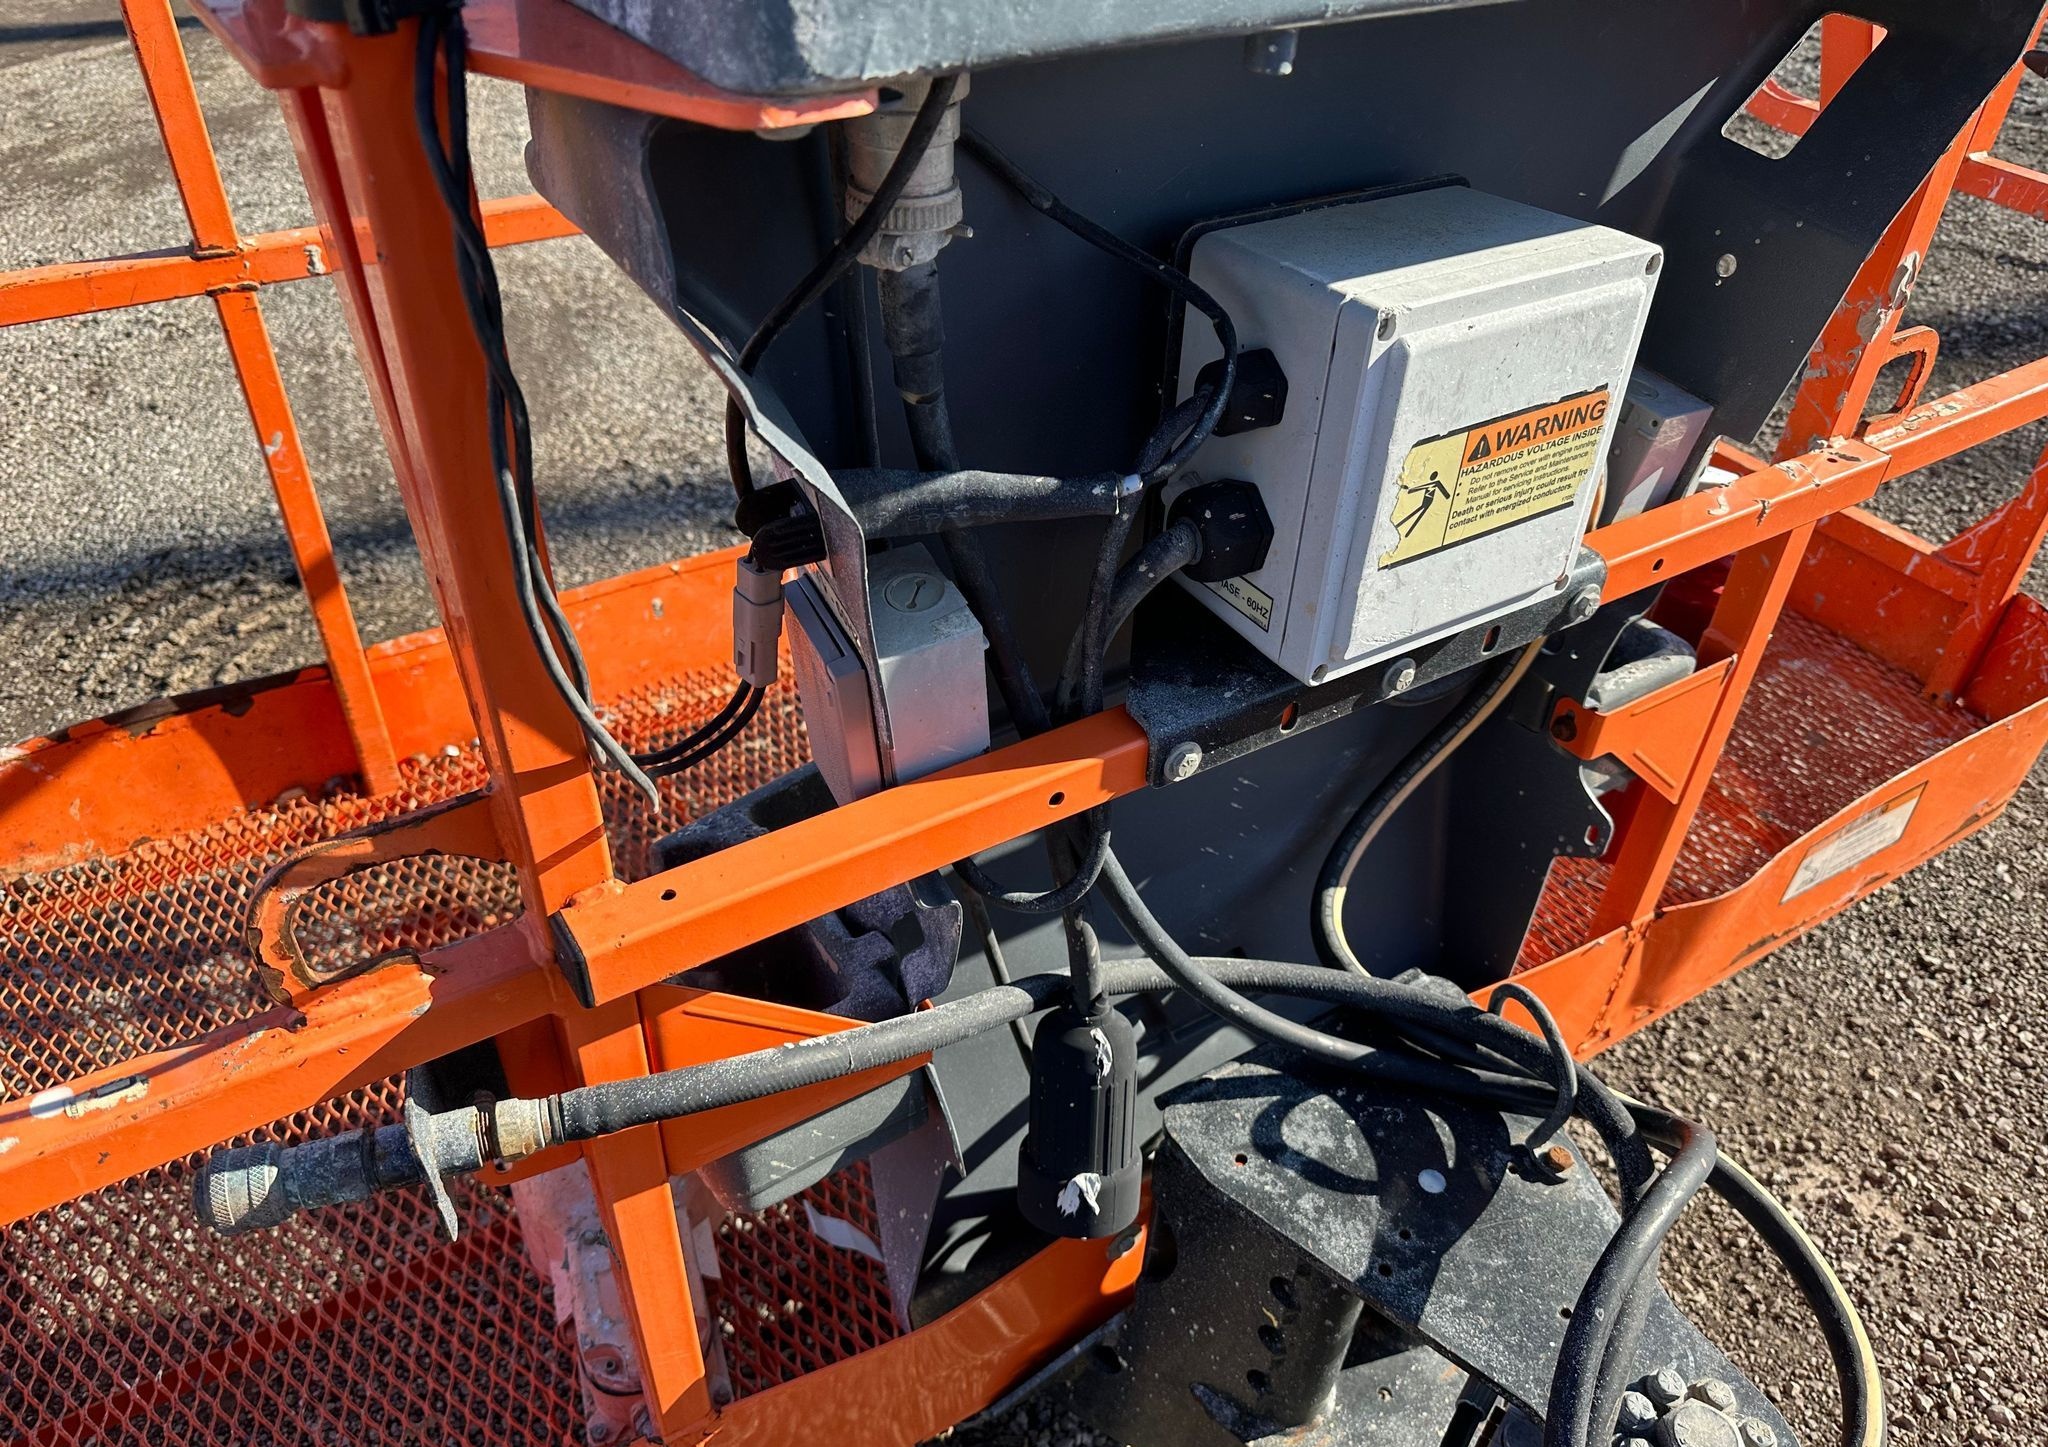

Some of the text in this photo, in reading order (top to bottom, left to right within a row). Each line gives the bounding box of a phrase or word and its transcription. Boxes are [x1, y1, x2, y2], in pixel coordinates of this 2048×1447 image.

[1496, 400, 1607, 451] WARNING
[1461, 425, 1603, 478] HAZARDOUS VOLTAGE INSIDE
[1467, 483, 1488, 495] Refer
[1496, 477, 1507, 486] the
[1508, 469, 1533, 481] Service
[1535, 465, 1548, 473] and
[1548, 451, 1589, 469] Maintenance
[1470, 477, 1480, 485] Do
[1482, 472, 1493, 481] not
[1494, 464, 1518, 477] remove
[1519, 458, 1538, 470] cover
[1538, 453, 1551, 462] with
[1551, 447, 1572, 458] engine
[1448, 515, 1478, 530] contact
[1479, 509, 1495, 519] with
[1495, 495, 1533, 511] energized
[1532, 483, 1573, 501] conductors.
[1451, 506, 1474, 519] Death
[1485, 494, 1512, 508] serious
[1514, 486, 1535, 499] injury
[1535, 478, 1556, 491] could
[1556, 471, 1577, 484] result
[1577, 468, 1589, 477] fro
[1465, 491, 1491, 505] Manual
[1494, 488, 1502, 496] for
[1502, 478, 1532, 493] servicing
[1246, 597, 1269, 620] 60HZ
